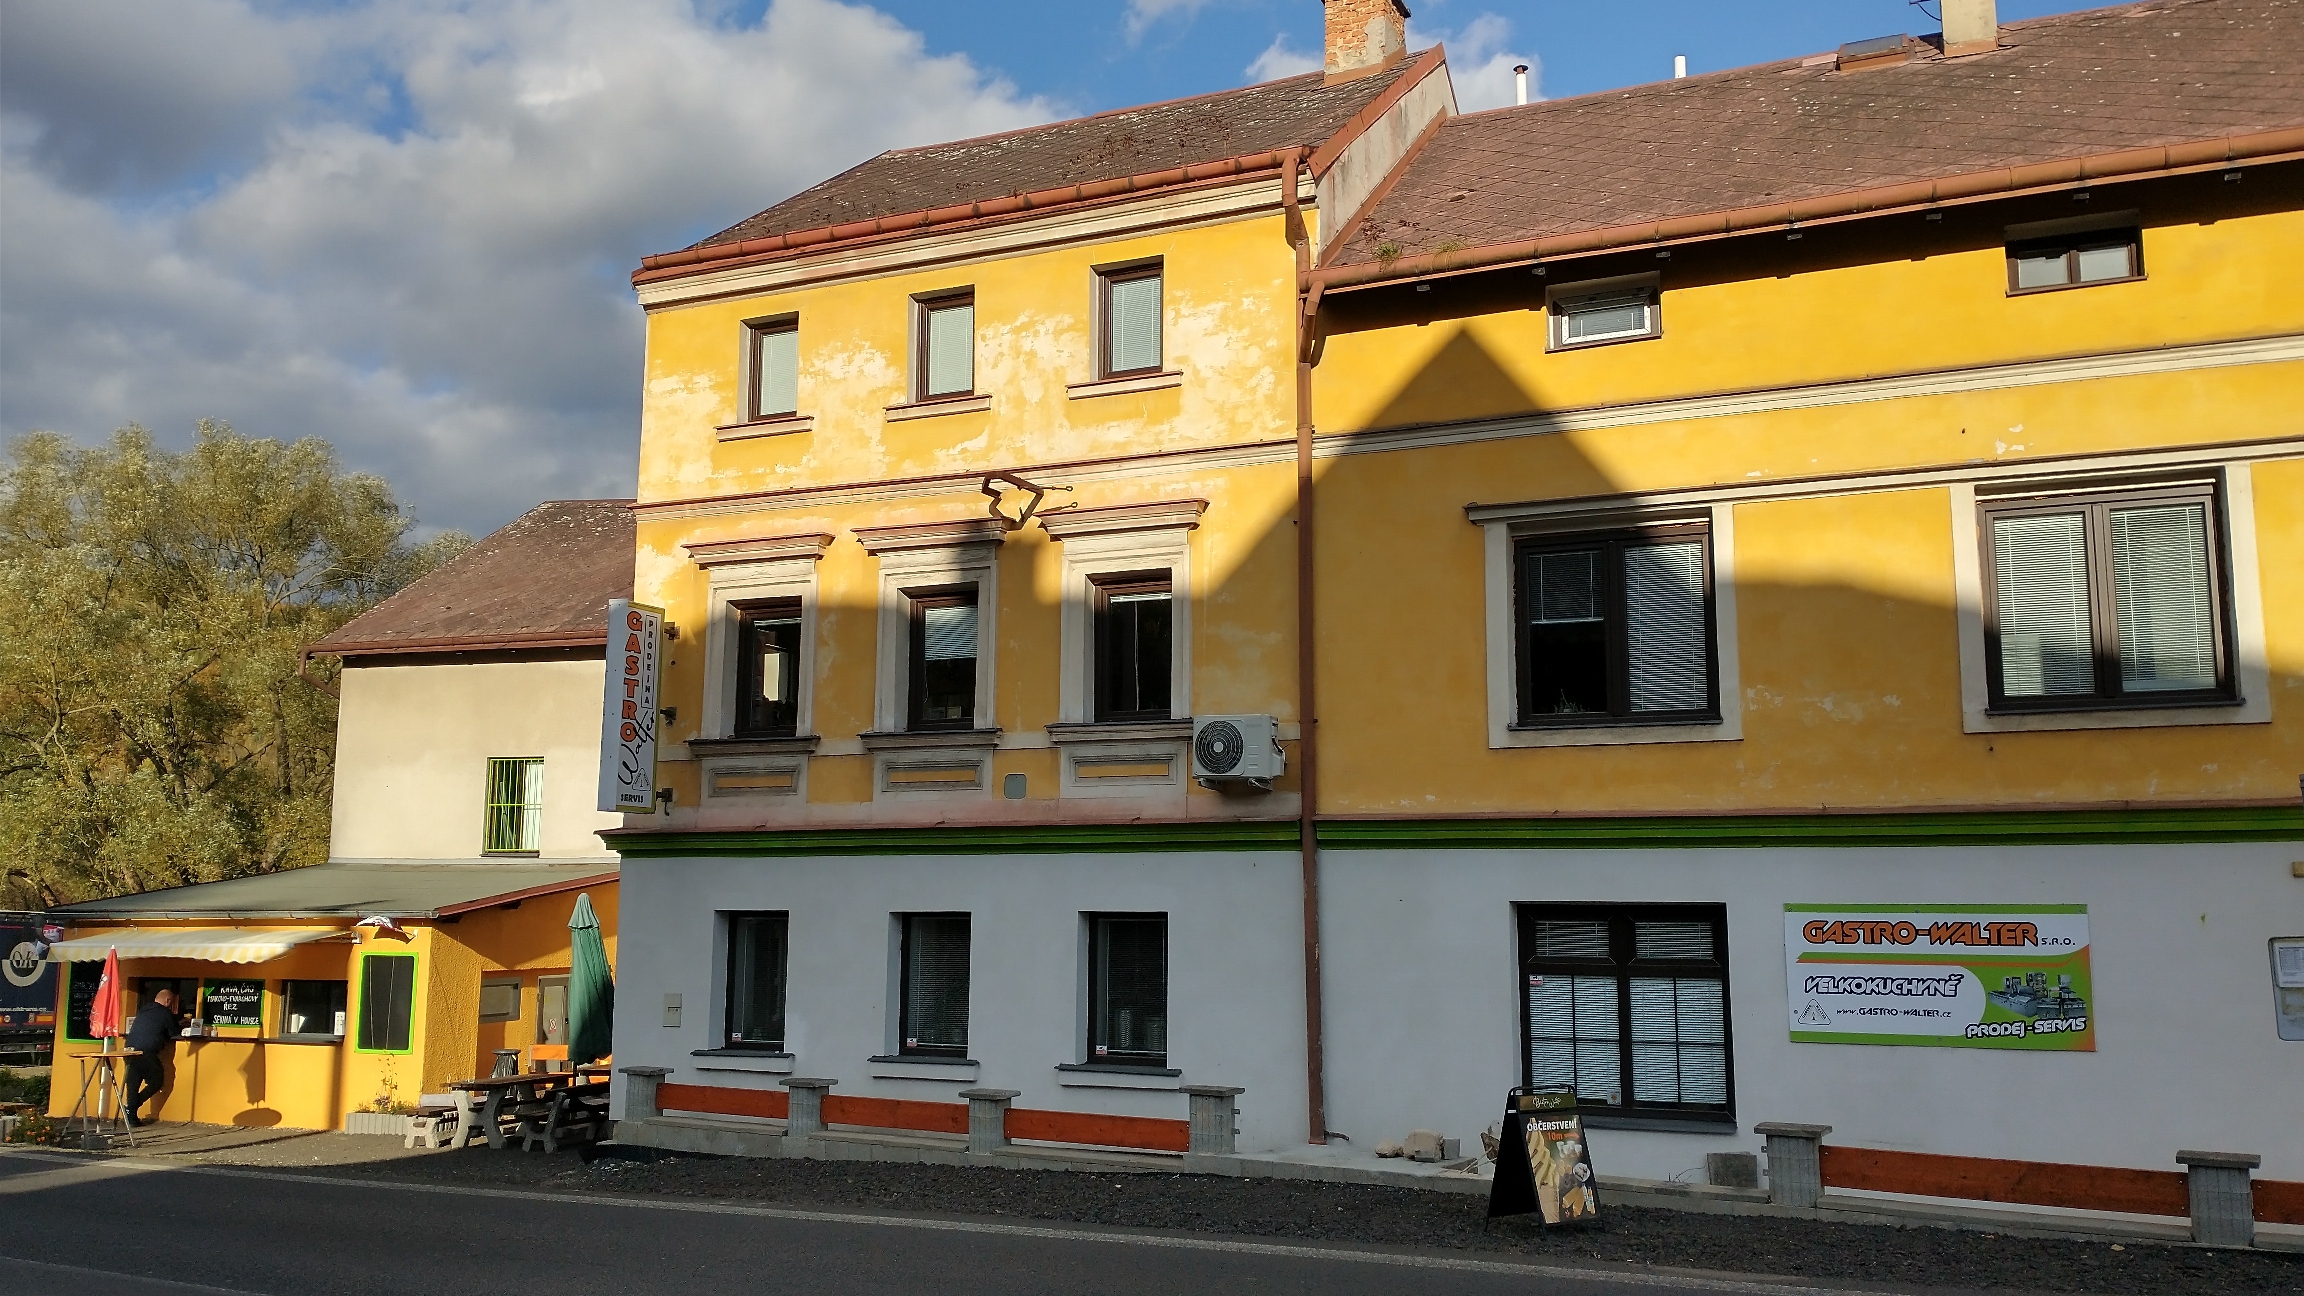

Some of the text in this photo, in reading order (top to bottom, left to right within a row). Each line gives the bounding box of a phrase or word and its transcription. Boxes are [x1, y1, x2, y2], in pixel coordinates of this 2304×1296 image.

[644, 619, 655, 705] PRODEJNA
[620, 611, 643, 743] GASTRO
[618, 710, 655, 786] Walter
[620, 793, 644, 804] SERVIS
[1802, 919, 2076, 947] GASTRO-WALTER S.R.O.
[1804, 974, 1965, 998] VELKOKUCHYNĚ
[223, 1001, 239, 1011] ŘEZ
[1526, 1117, 1577, 1132] OBČERSTVENÍ
